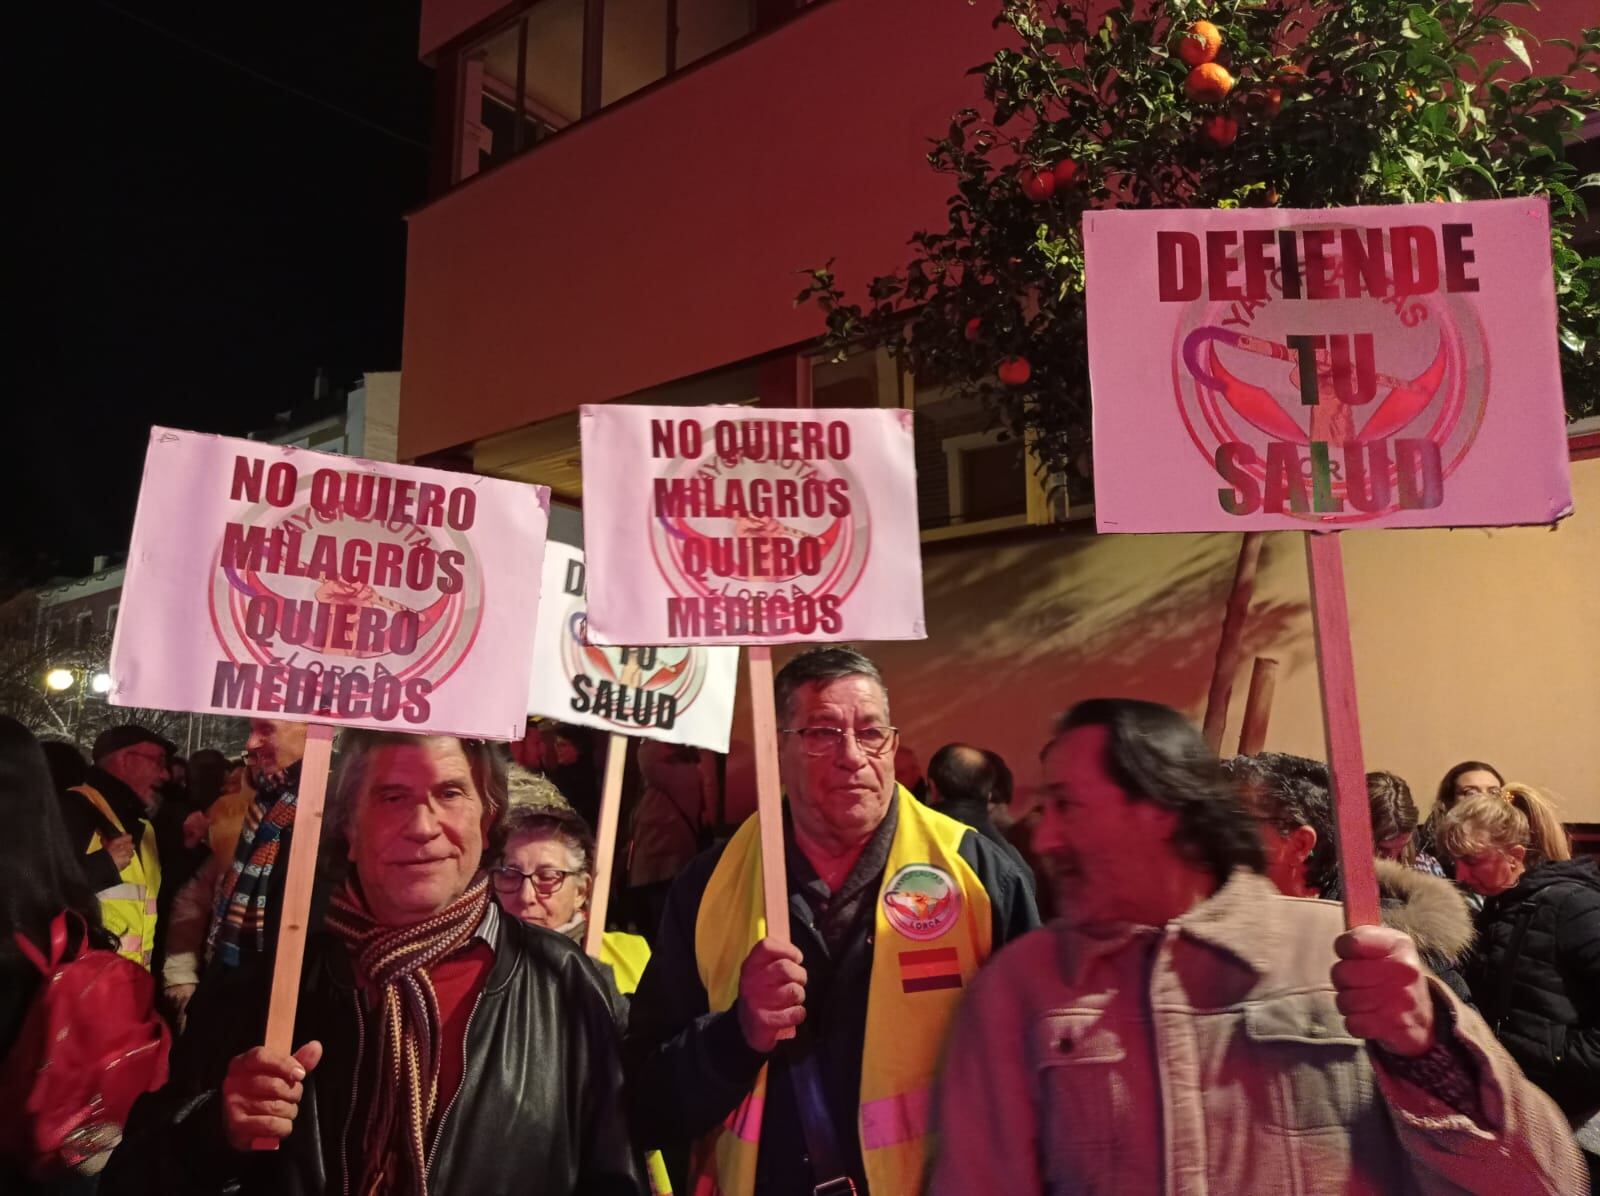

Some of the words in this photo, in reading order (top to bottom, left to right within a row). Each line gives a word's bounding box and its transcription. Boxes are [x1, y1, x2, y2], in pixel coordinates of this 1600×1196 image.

[1156, 222, 1480, 302] DEFIENDE
[1286, 332, 1377, 406] TU
[651, 418, 702, 459] NO
[714, 419, 851, 464] QUIERO
[230, 455, 298, 508] NO
[310, 468, 476, 532] QUIERO
[654, 477, 851, 519] MILAGROS
[1214, 438, 1444, 516] SALUD
[220, 522, 465, 595] MILAGROS
[683, 536, 822, 582] QUIERO
[245, 594, 420, 656] QUIERO
[211, 655, 433, 723] MÉDICOS
[570, 673, 678, 730] SALUD
